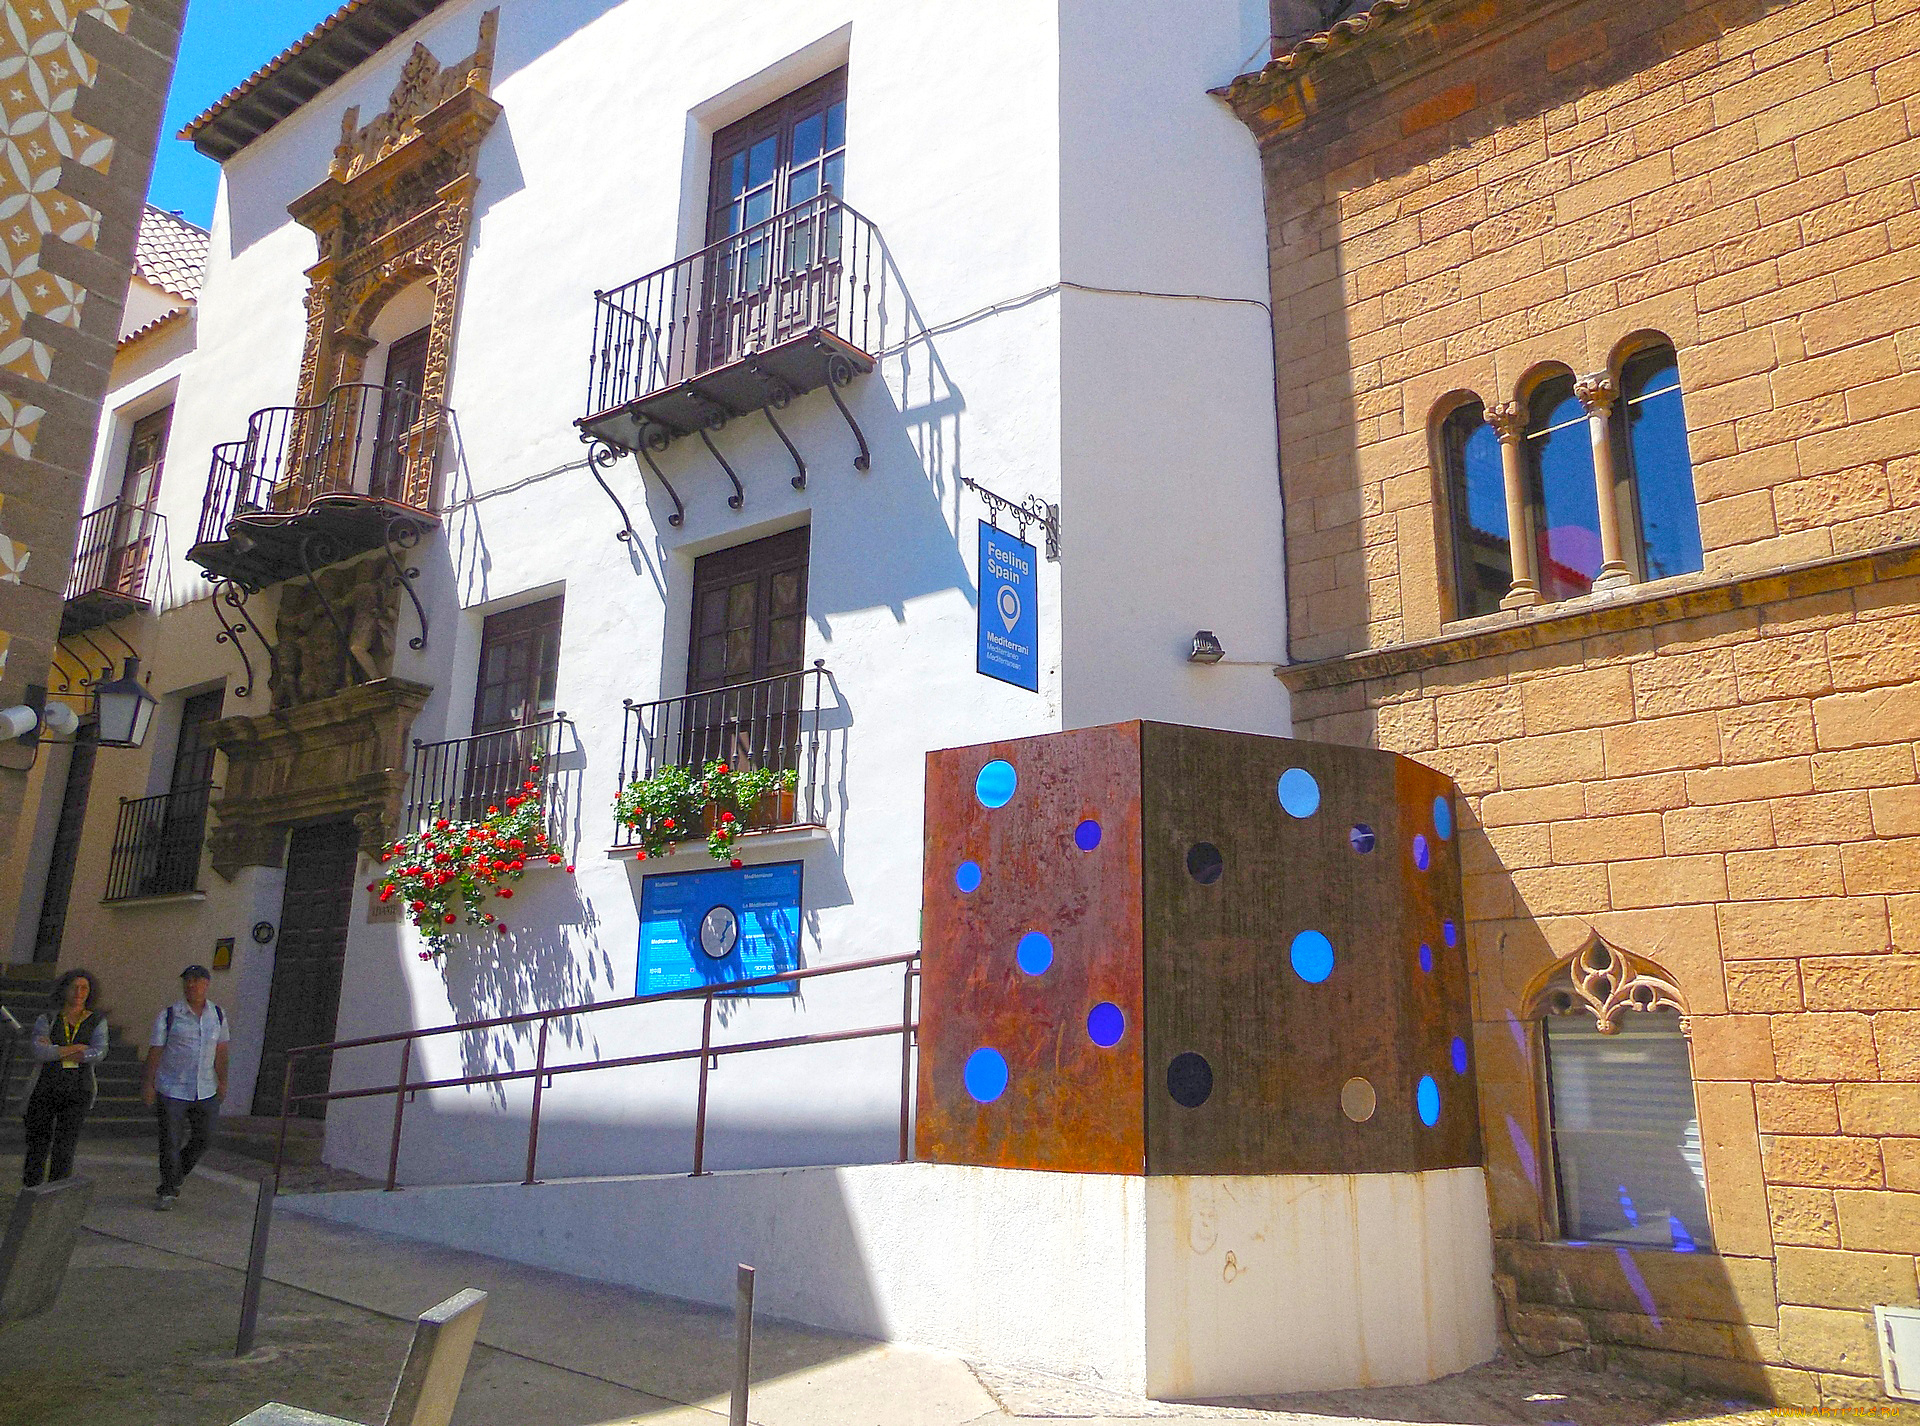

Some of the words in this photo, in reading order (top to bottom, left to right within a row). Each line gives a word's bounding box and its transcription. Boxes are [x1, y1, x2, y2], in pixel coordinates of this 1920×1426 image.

[987, 541, 1029, 576] Feeling
[987, 558, 1020, 584] Spain
[986, 630, 1029, 656] Mediterrani
